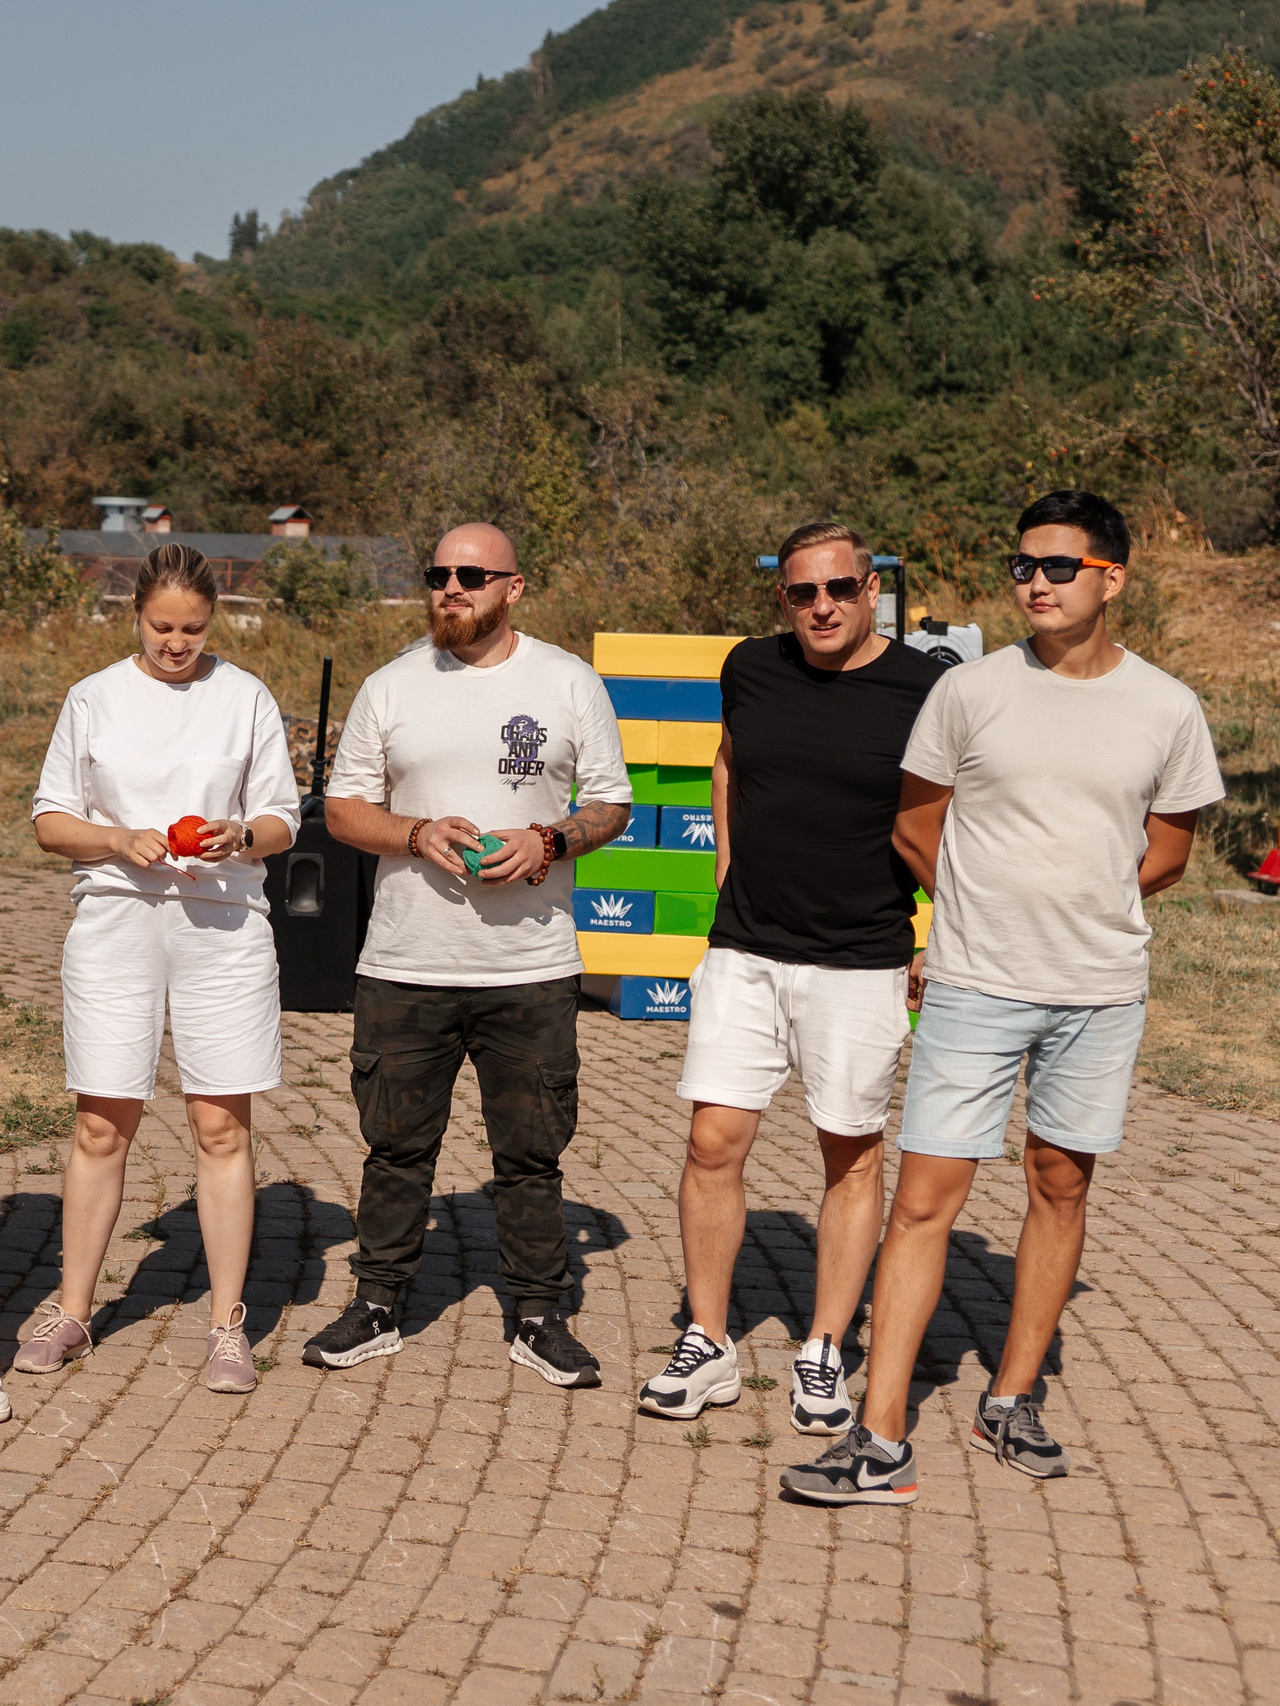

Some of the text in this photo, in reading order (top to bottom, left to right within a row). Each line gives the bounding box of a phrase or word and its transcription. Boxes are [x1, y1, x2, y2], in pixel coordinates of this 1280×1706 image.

[507, 742, 539, 759] AND
[498, 758, 546, 776] ORDER
[682, 813, 714, 822] ESTRO
[590, 918, 632, 928] MAESTRO
[646, 1006, 687, 1014] MAESTRO
